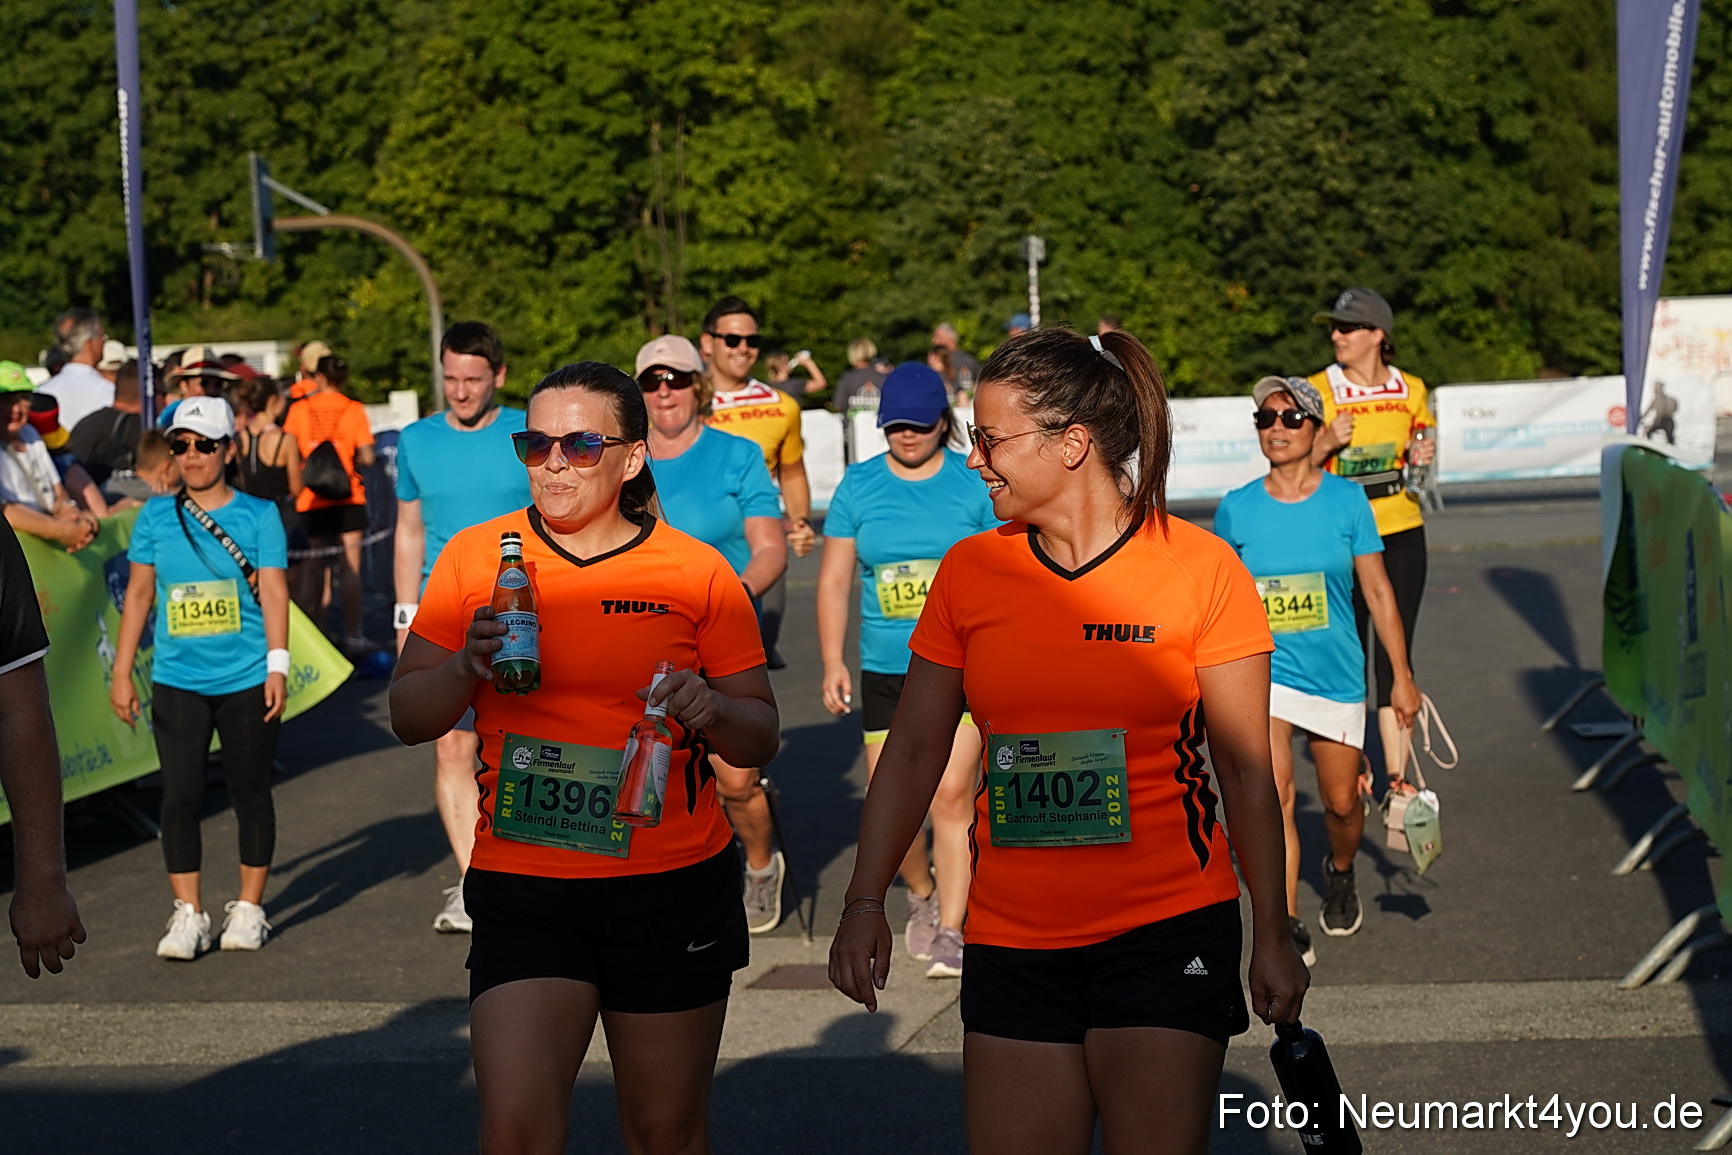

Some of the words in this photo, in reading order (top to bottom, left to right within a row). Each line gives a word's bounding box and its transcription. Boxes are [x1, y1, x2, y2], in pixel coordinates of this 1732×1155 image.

[179, 599, 227, 620] 1346
[601, 600, 670, 615] THULE
[1262, 593, 1315, 616] 1344
[1082, 624, 1156, 643] THULE
[533, 759, 576, 770] Firmenlauf
[1015, 753, 1056, 764] Firmenlauf
[501, 782, 515, 818] RUN
[520, 773, 612, 819] 1396
[1007, 770, 1102, 809] 1402
[1105, 774, 1122, 827] 2022
[994, 786, 1007, 824] RUN
[515, 810, 558, 828] Steindl
[561, 817, 607, 834] Bettina
[1005, 812, 1047, 824] Garthoff
[1049, 810, 1108, 825] Stephanie
[1184, 967, 1208, 975] adidas
